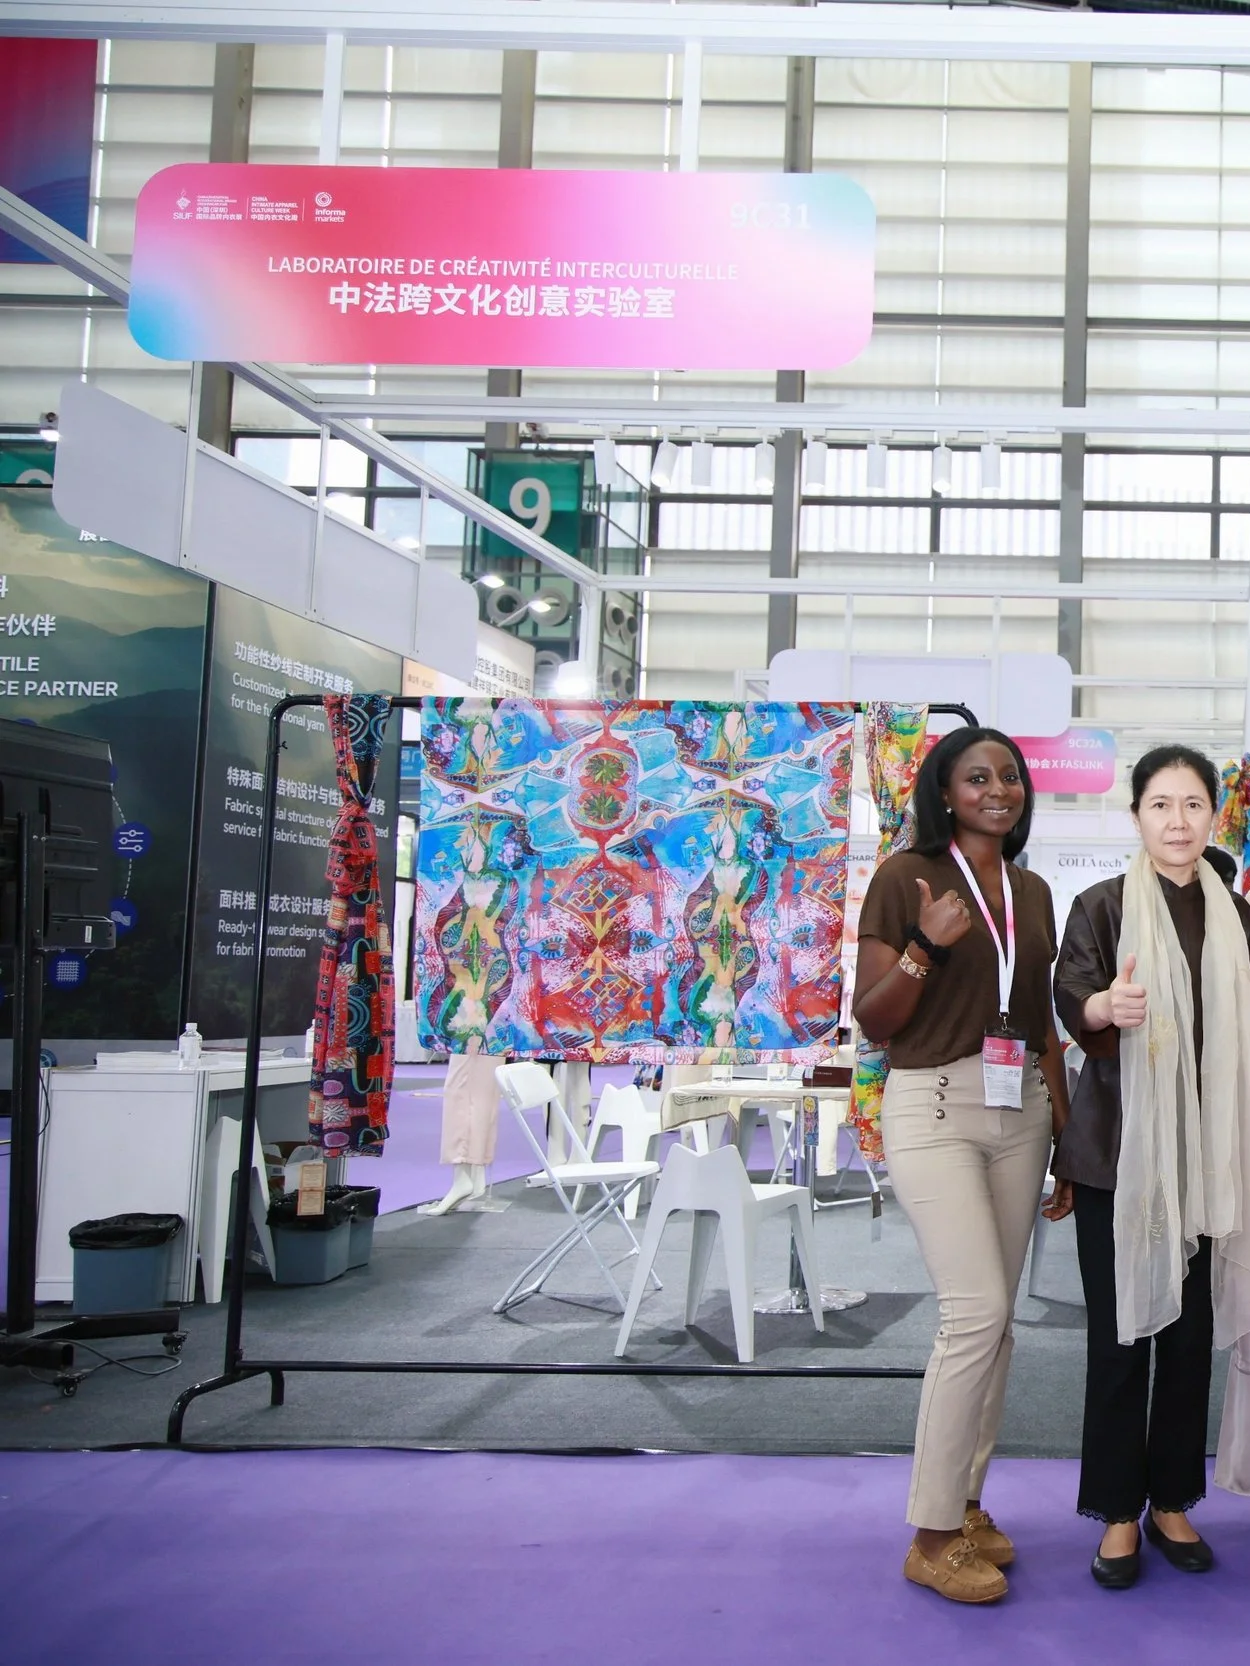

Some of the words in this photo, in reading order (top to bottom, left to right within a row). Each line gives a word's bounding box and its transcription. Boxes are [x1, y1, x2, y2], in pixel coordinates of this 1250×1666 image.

[315, 208, 346, 216] informa
[730, 201, 812, 230] 9C31
[268, 256, 404, 275] LABORATOIRE
[410, 258, 435, 275] DE
[440, 256, 551, 277] CRÉATIVITÉ
[556, 260, 738, 281] INTERCULTURELLE
[328, 281, 676, 319] 中法跨文化创意实验室
[509, 477, 551, 537] 9
[234, 641, 354, 694] 功能性纱线定制开发服务
[24, 680, 119, 697] PARTNER
[232, 671, 287, 700] Customized
[231, 693, 245, 709] for
[246, 699, 263, 714] the
[307, 718, 325, 732] yarn
[1068, 738, 1103, 749] 9C32A
[1060, 759, 1104, 770] FASLINK
[224, 797, 254, 815] Fabric
[287, 810, 328, 827] structure
[223, 821, 252, 836] service
[273, 828, 297, 843] fabric
[299, 833, 331, 848] function
[1058, 857, 1096, 868] COLLA
[1098, 858, 1122, 868] tech
[219, 889, 332, 917] 面料推成衣设计服务
[289, 924, 317, 941] design
[217, 941, 231, 956] for
[232, 941, 255, 956] fabri
[266, 946, 307, 958] romotion
